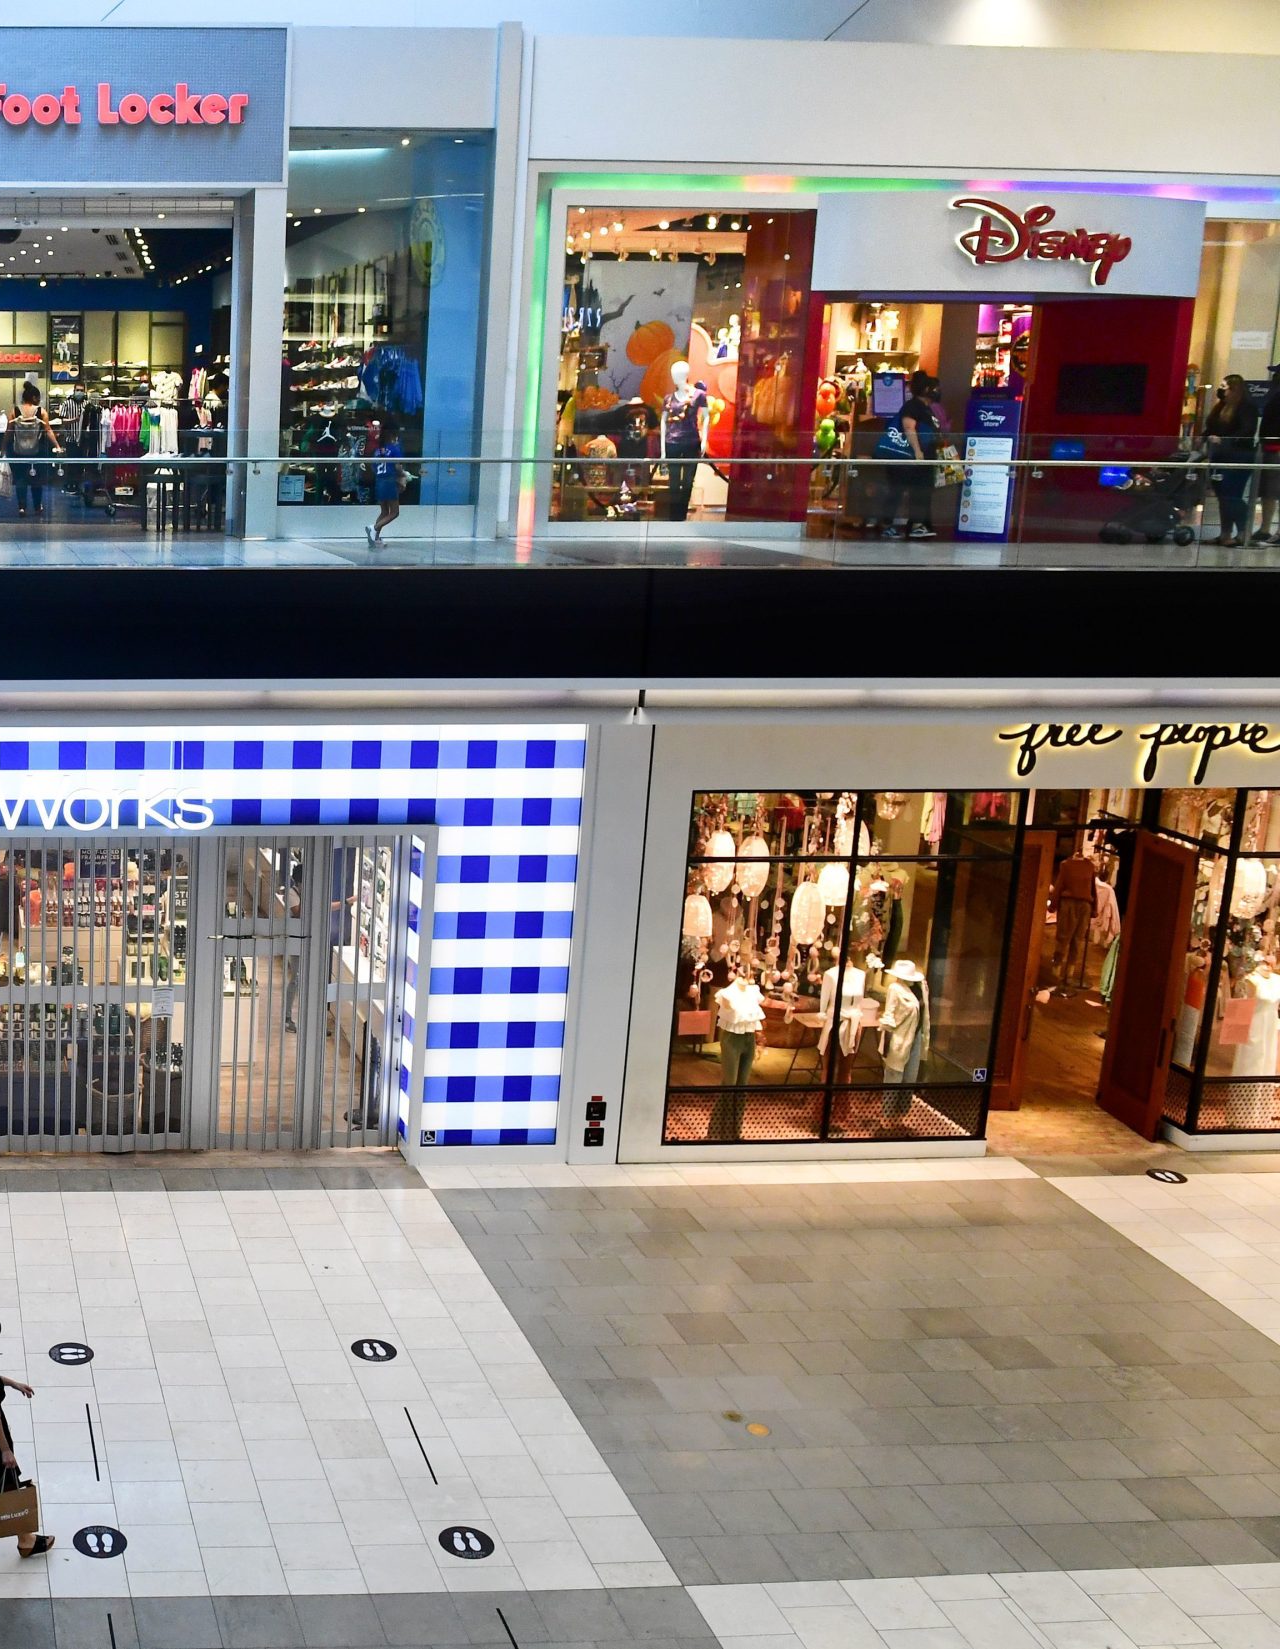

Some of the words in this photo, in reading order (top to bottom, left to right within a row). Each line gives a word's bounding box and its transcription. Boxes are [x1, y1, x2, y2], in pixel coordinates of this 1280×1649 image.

[97, 83, 249, 125] Locker
[949, 196, 1132, 286] Disney
[977, 409, 1006, 424] Disney
